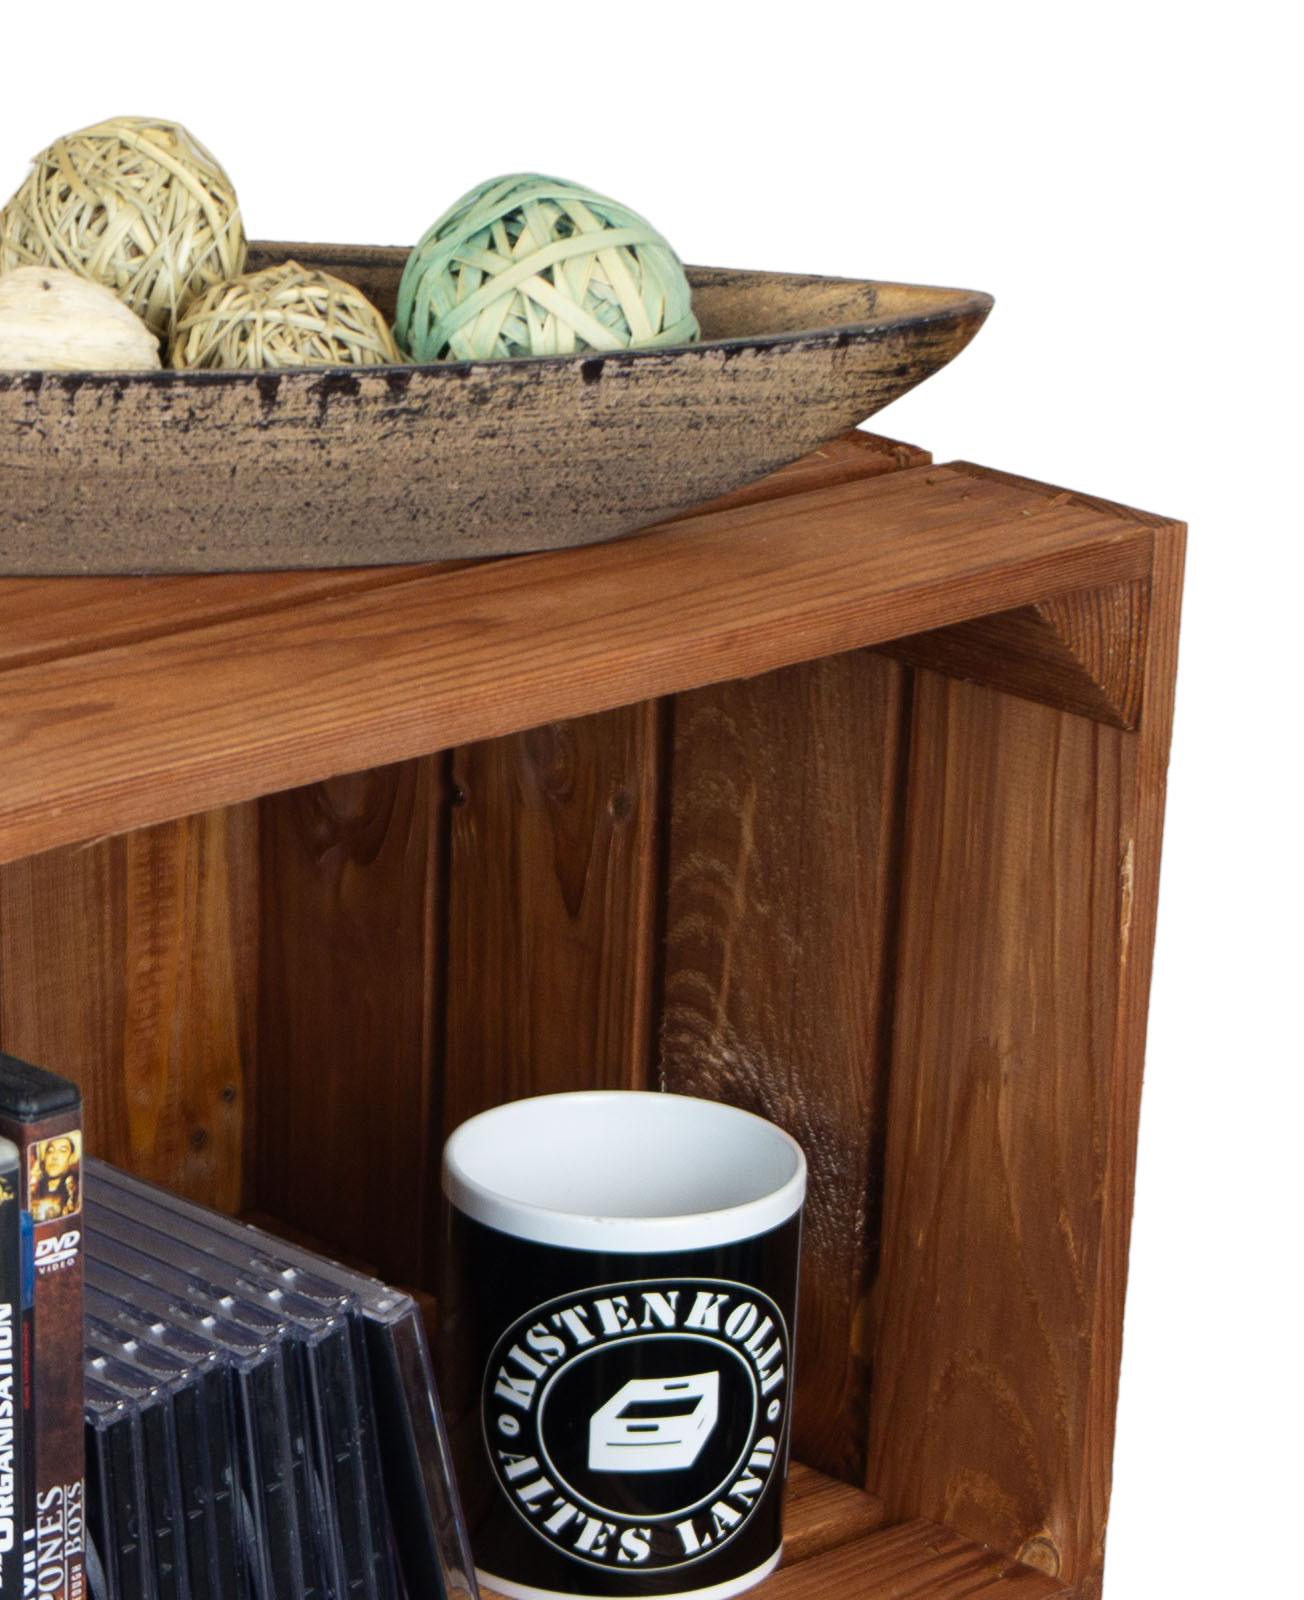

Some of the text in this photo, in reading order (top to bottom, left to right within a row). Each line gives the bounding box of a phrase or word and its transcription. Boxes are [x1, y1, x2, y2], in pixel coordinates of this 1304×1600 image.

[35, 1230, 80, 1257] DVD
[39, 1258, 75, 1275] VIDEO
[495, 1291, 785, 1411] KISTENKOLLI
[65, 1480, 83, 1557] BOYS
[498, 1435, 776, 1563] ALTES LAND
